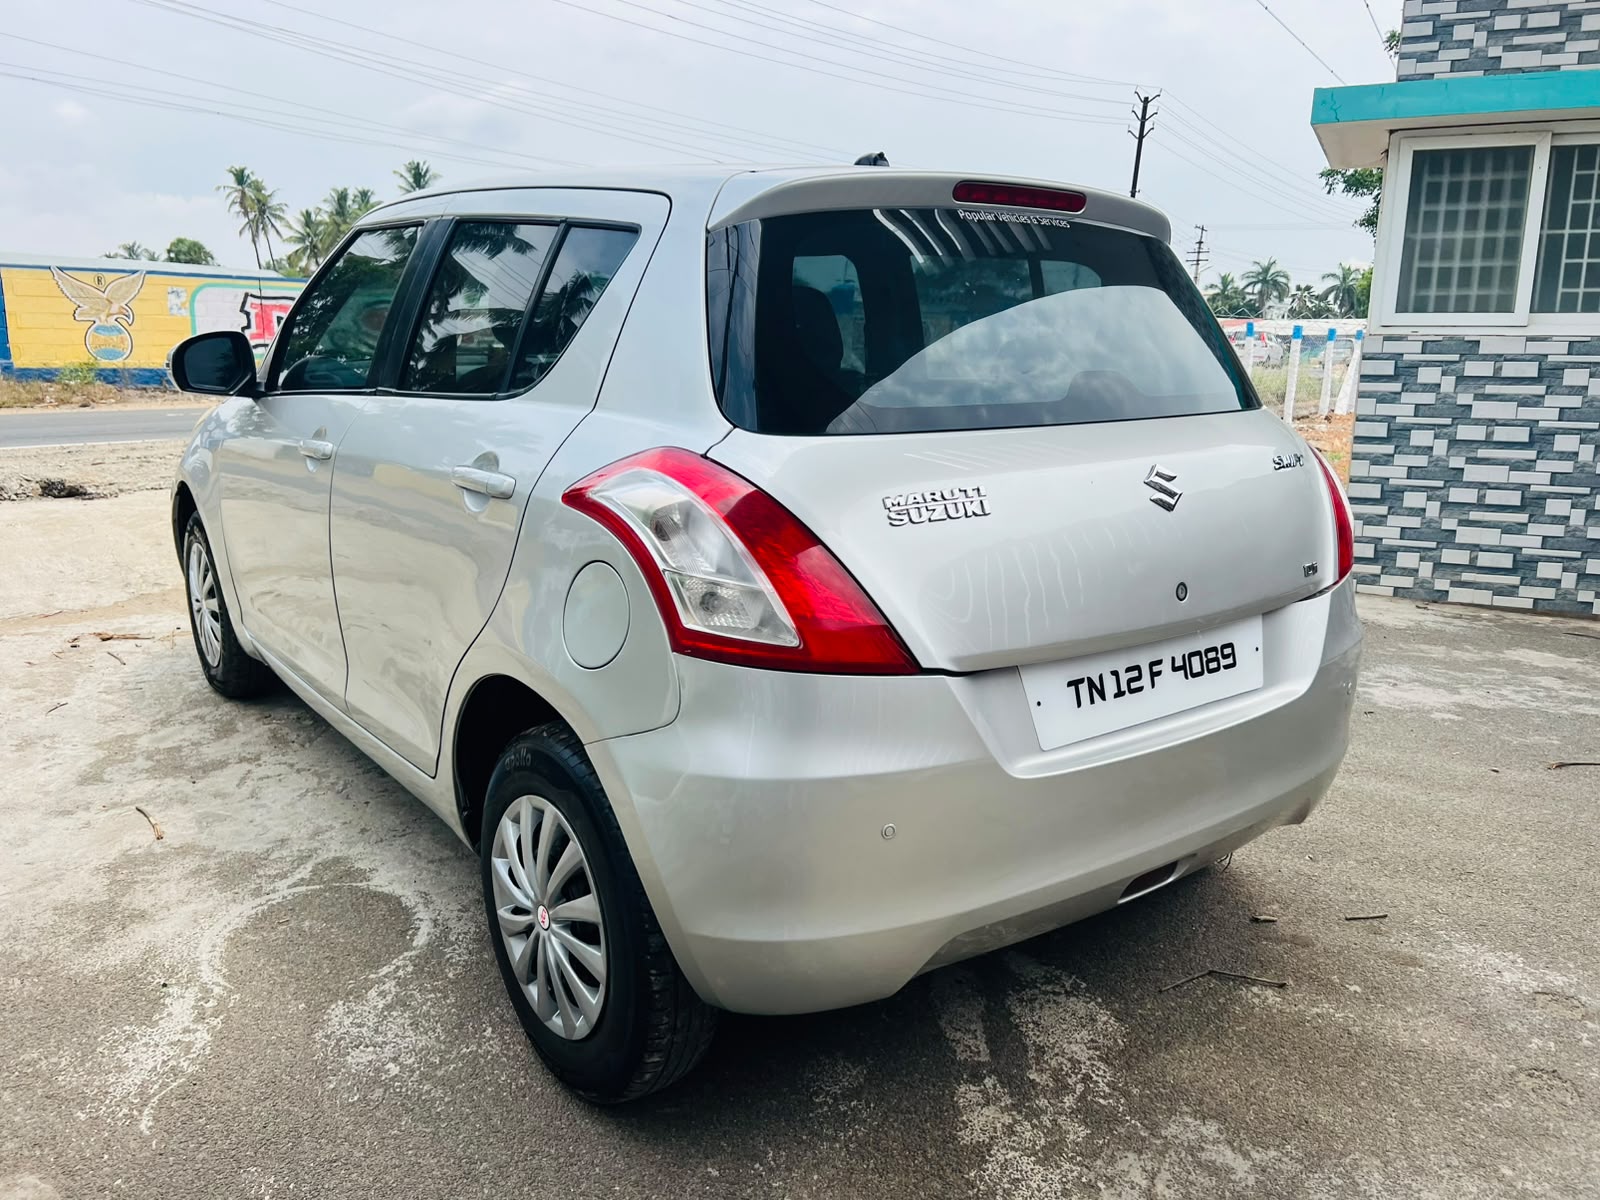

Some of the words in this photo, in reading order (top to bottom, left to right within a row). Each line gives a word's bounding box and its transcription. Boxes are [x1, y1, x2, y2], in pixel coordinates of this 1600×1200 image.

[957, 209, 995, 223] Popular
[995, 212, 1030, 225] Vehicles
[1030, 216, 1039, 225] &
[1039, 217, 1071, 228] Services
[882, 485, 987, 510] MARUTI
[887, 499, 991, 527] SUZUKI
[1066, 673, 1107, 709] TN
[1113, 664, 1145, 699] 12
[1148, 658, 1164, 689] F
[1171, 642, 1237, 681] 4089
